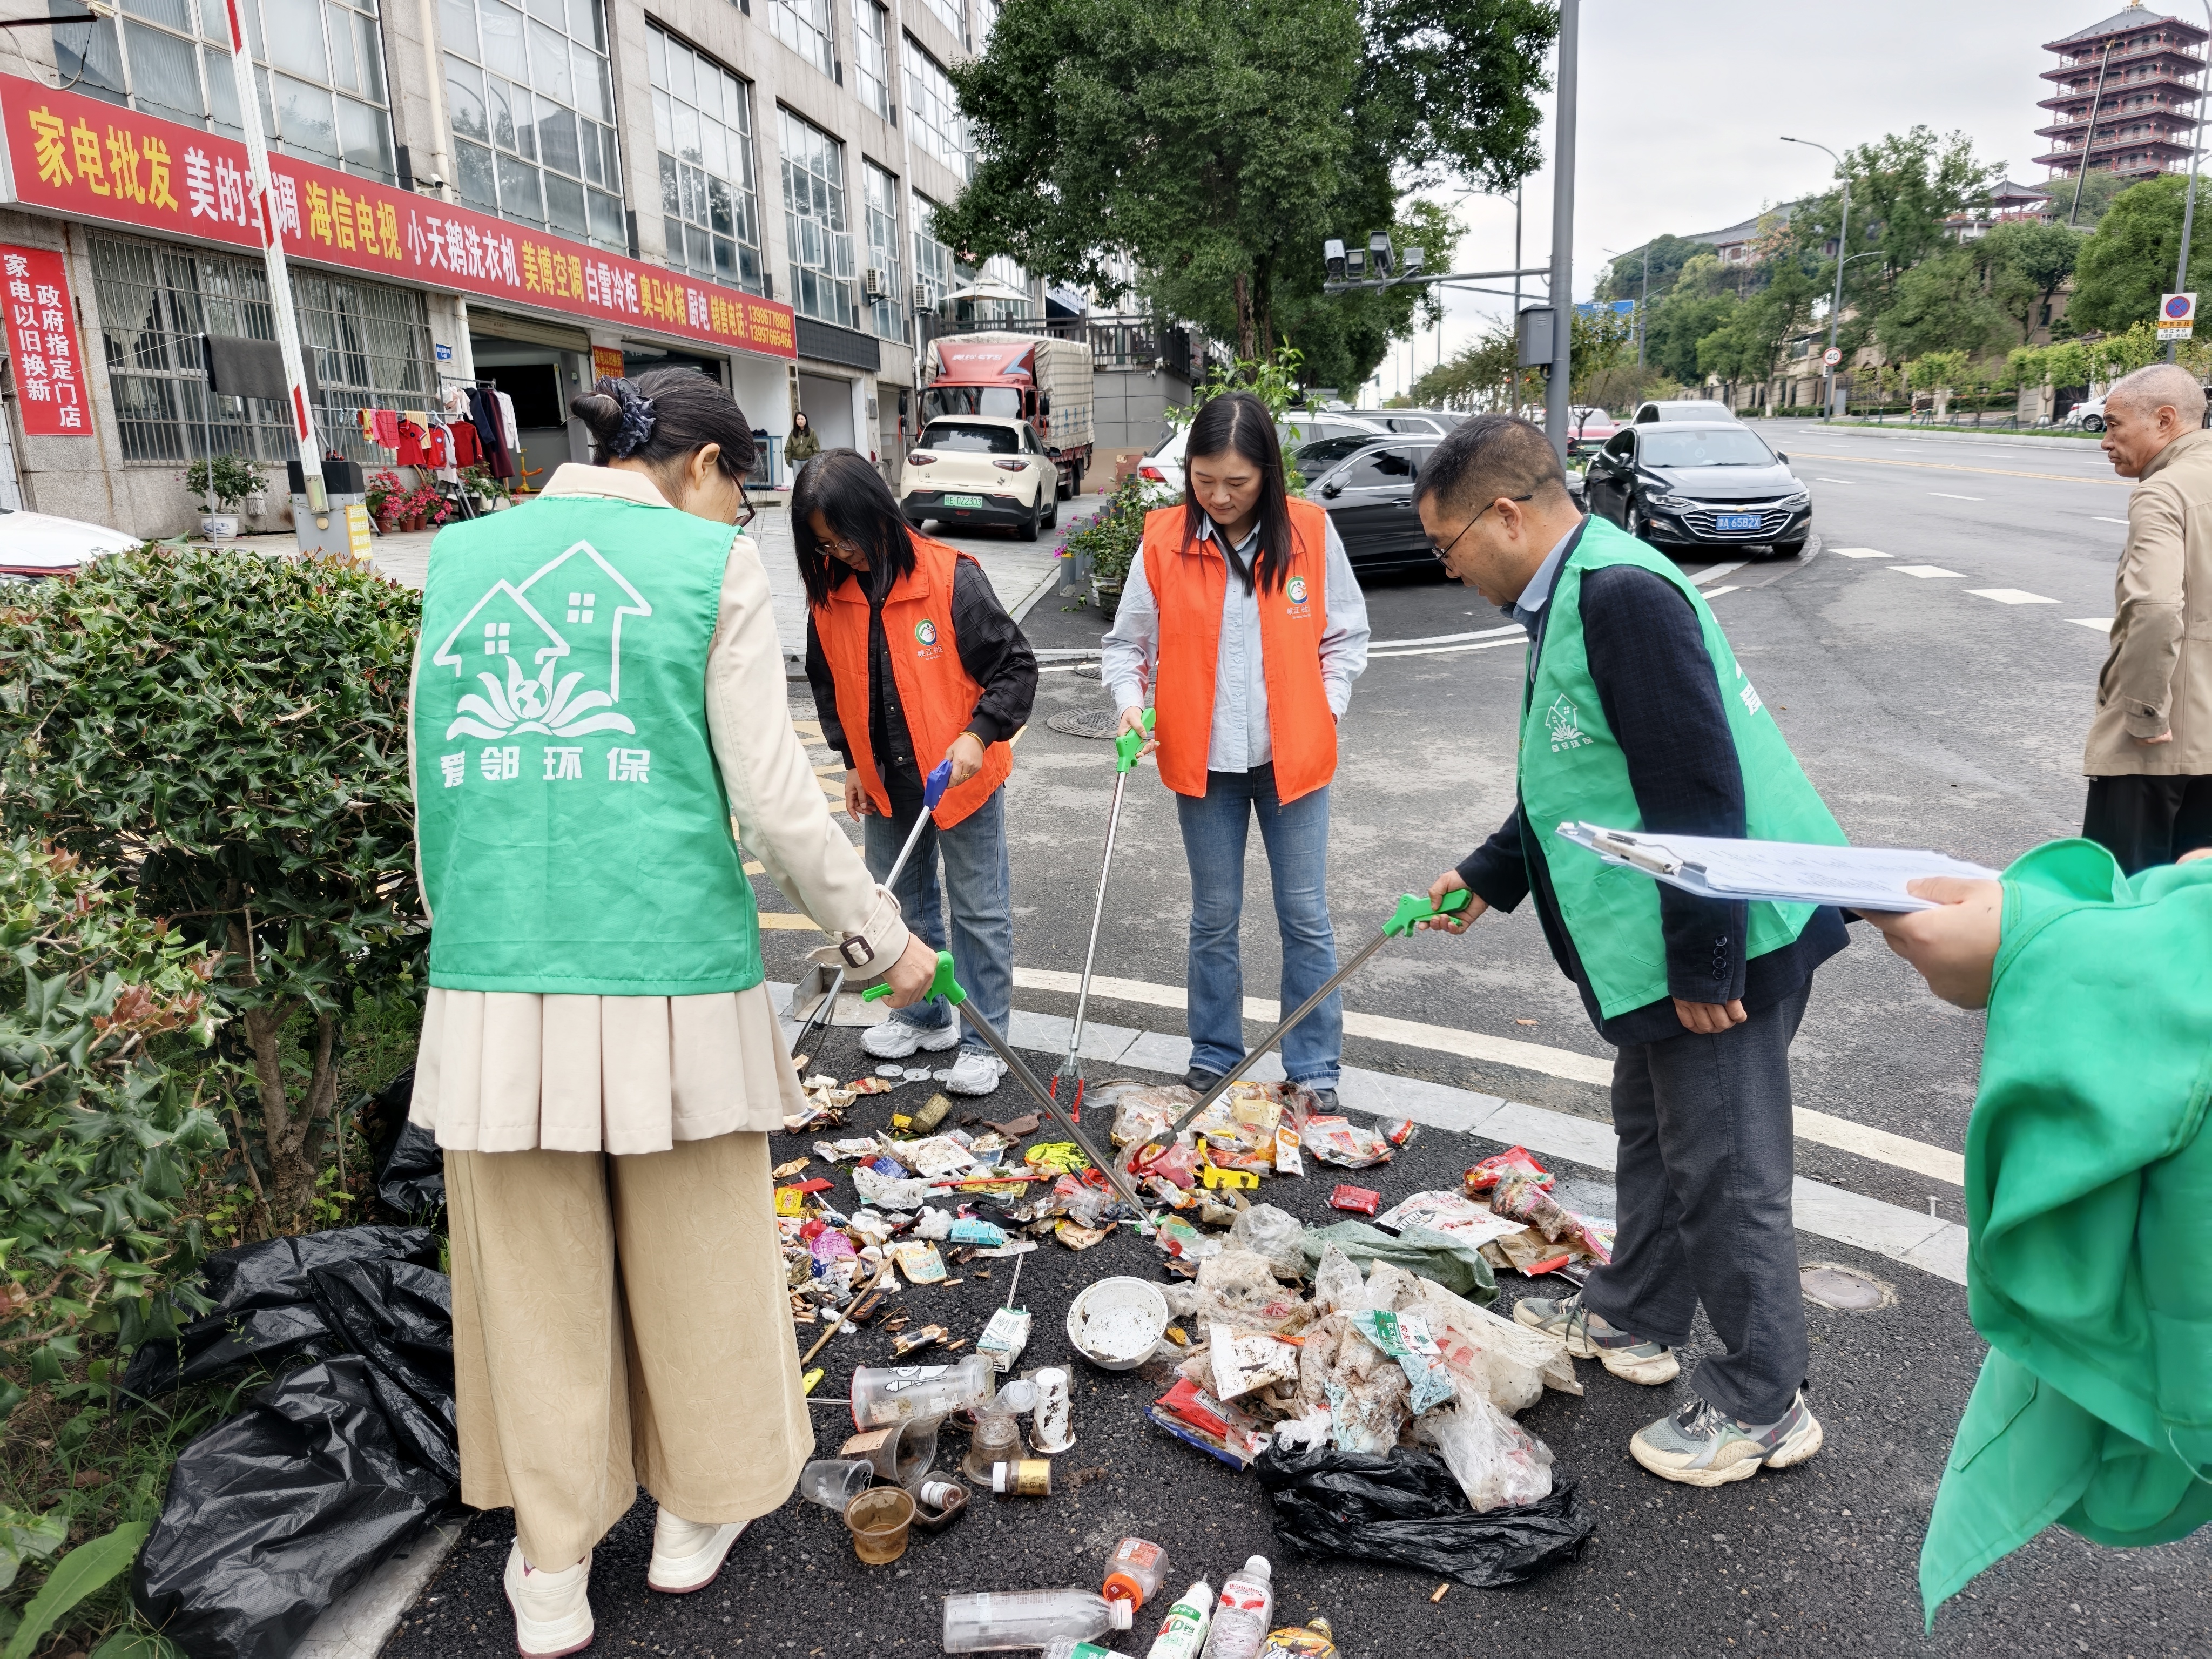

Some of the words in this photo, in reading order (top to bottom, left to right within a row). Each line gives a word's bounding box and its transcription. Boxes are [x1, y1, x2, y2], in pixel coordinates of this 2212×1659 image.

[29, 106, 178, 212] 家电批发
[306, 180, 402, 261] 海信电视
[408, 210, 520, 287] 小天鹅洗衣机
[521, 240, 585, 304] 美博空调
[585, 258, 639, 314] 白雪冷柜
[640, 273, 686, 327] 奥马冰箱
[687, 287, 710, 331] 厨电
[3, 253, 51, 403] 家电以旧换新
[748, 305, 791, 331] 13986778880
[750, 324, 792, 349] 13997665466
[36, 285, 82, 429] 政府指定门店
[594, 349, 622, 367] 家电以旧换新
[1826, 353, 1838, 361] 40
[440, 745, 651, 788] 爱邻环保
[995, 1315, 1020, 1336] 纯牛奶
